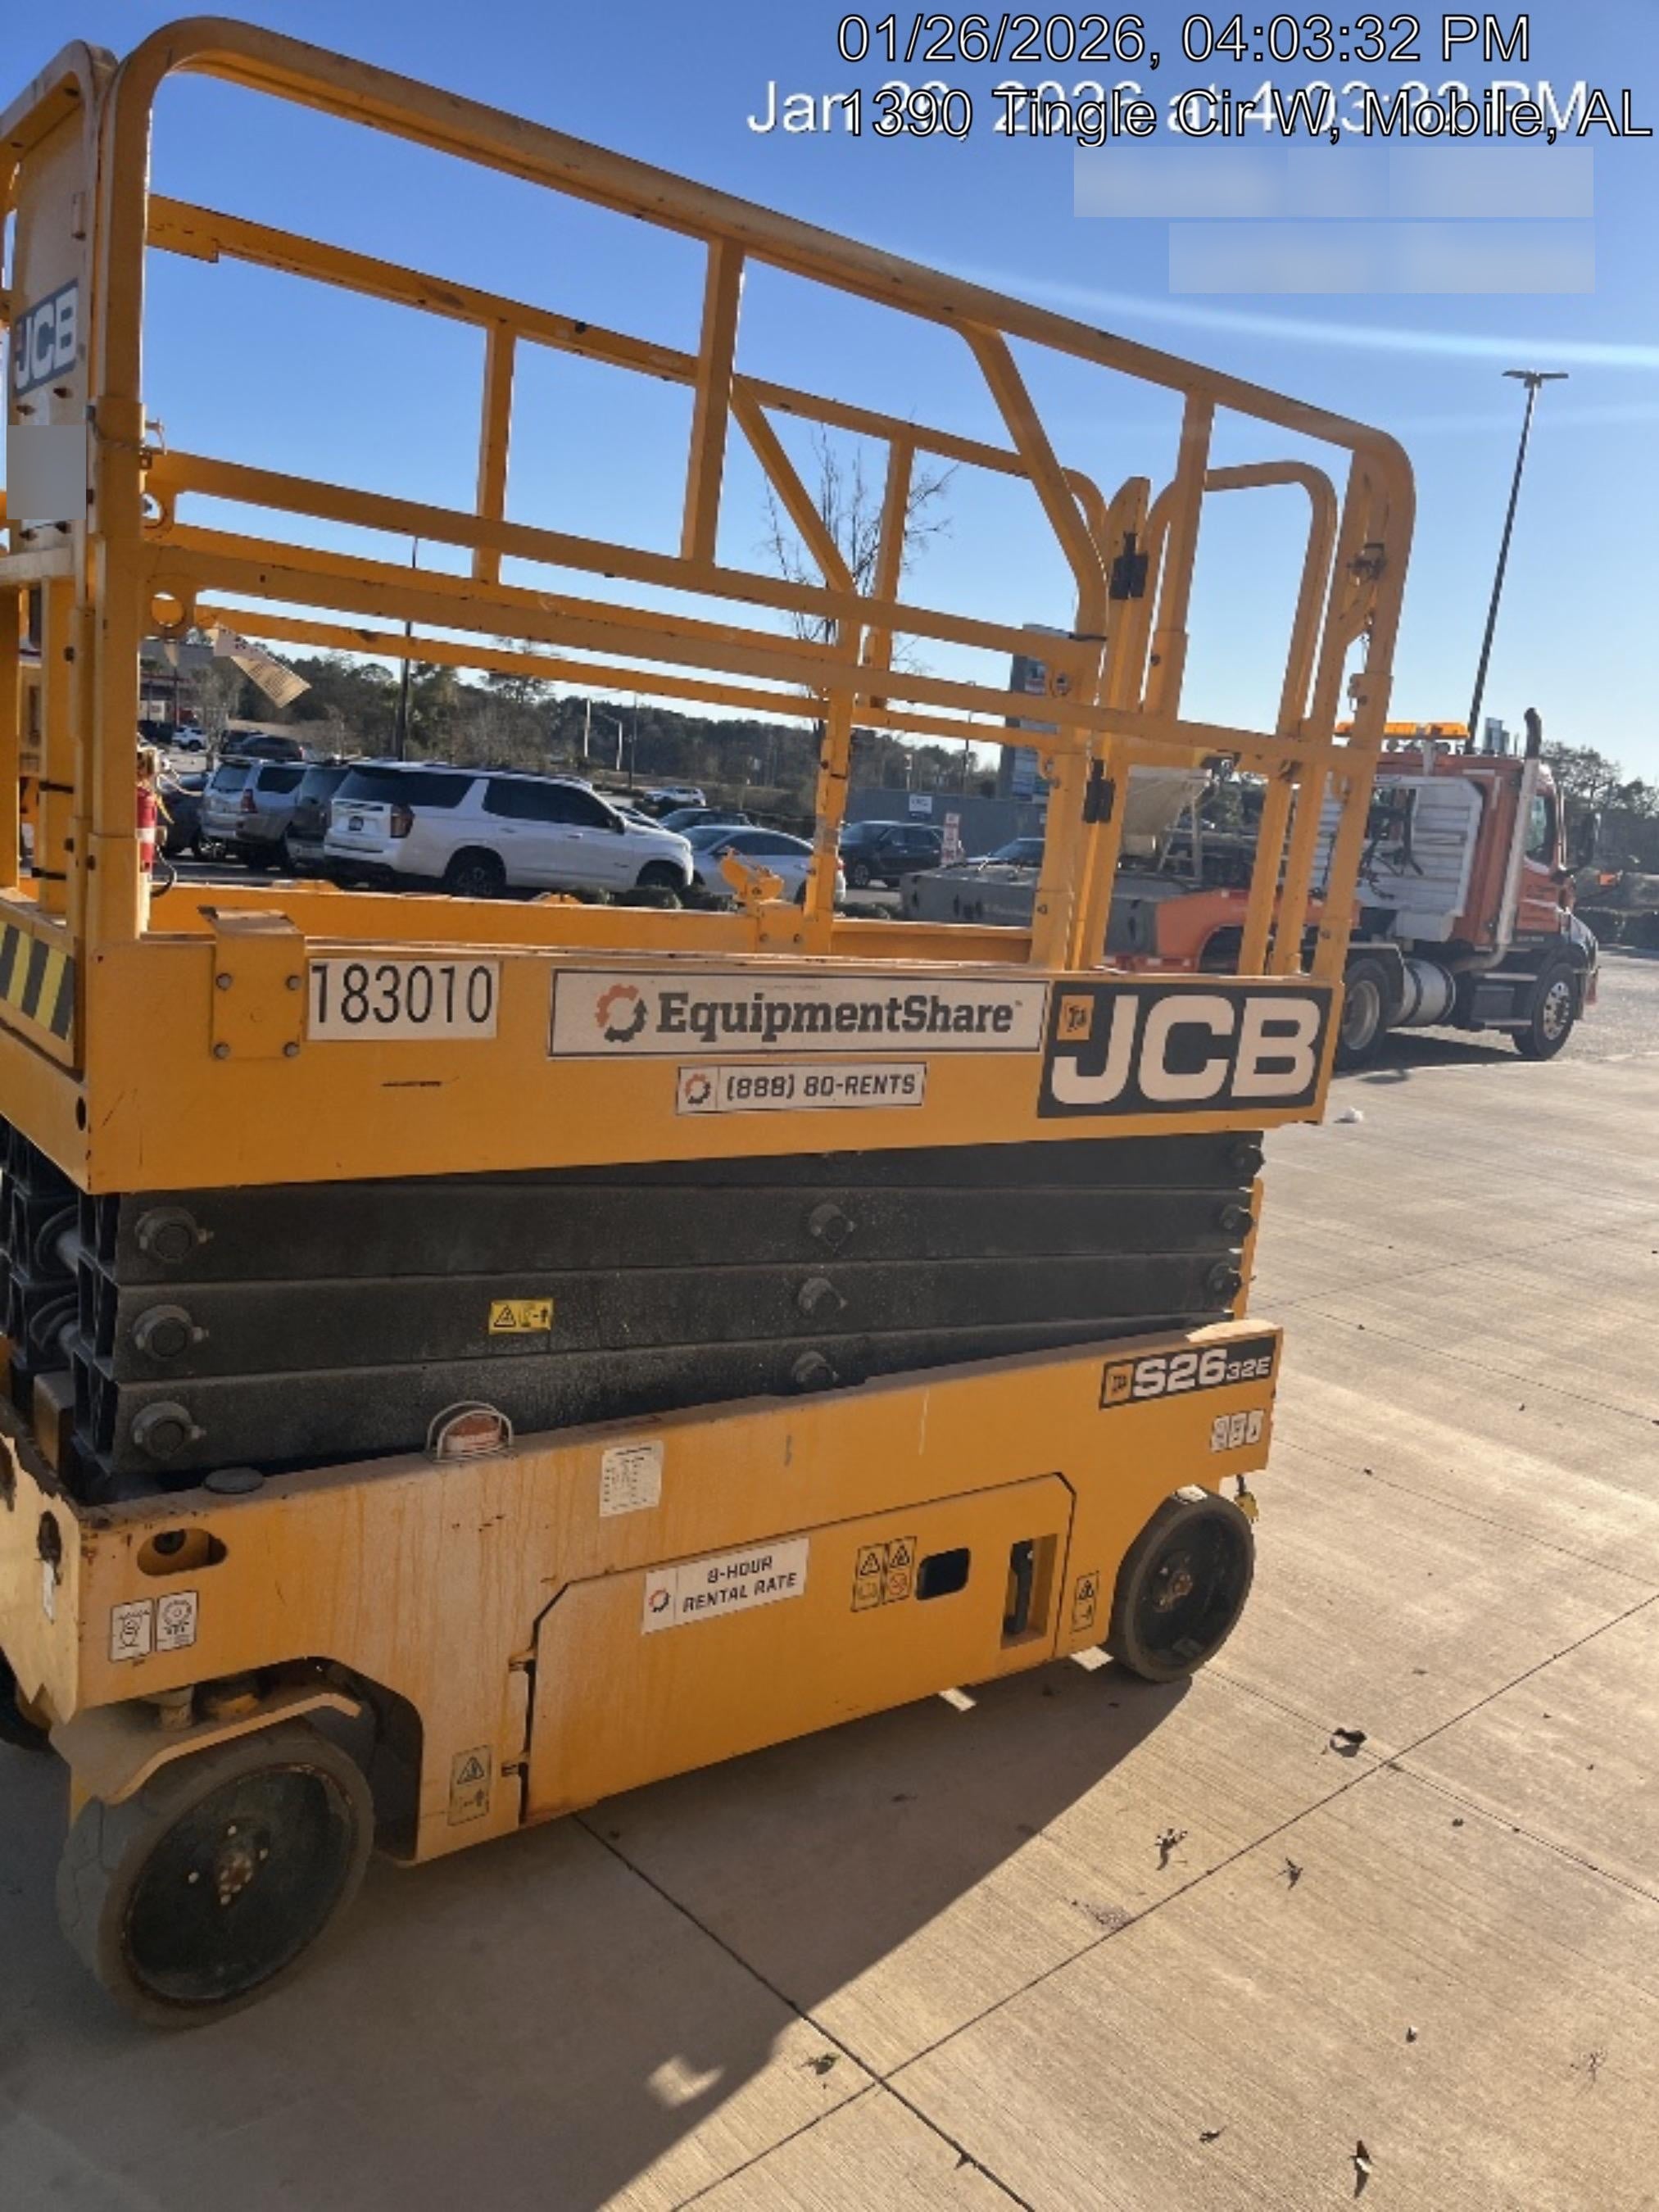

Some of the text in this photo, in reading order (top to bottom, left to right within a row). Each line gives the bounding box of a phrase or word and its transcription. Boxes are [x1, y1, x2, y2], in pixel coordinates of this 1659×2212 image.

[16, 287, 78, 390] JCB
[310, 964, 492, 1024] 183010
[655, 990, 1014, 1042] EquipmentShare
[1051, 995, 1321, 1104] JCB
[726, 1072, 915, 1099] (888) 80-RENTS
[682, 1572, 797, 1612] RENTAL RATE
[707, 1556, 773, 1584] 8-HOUR
